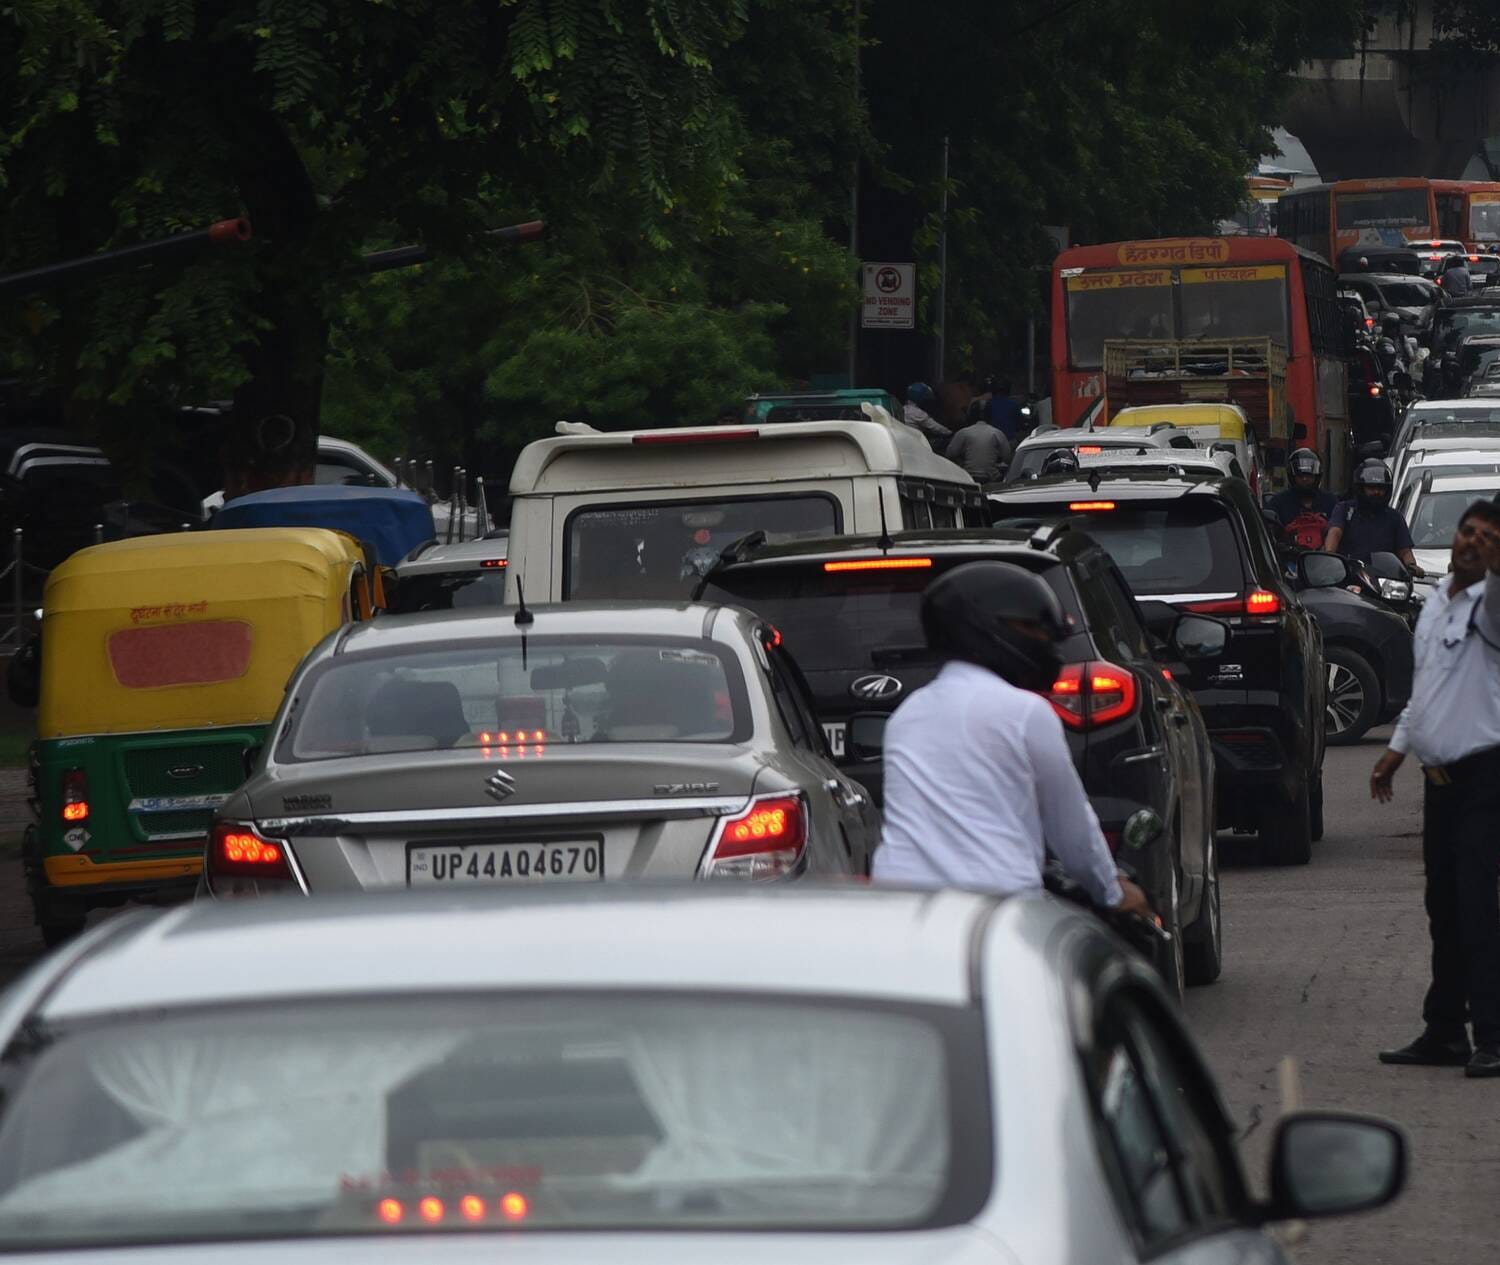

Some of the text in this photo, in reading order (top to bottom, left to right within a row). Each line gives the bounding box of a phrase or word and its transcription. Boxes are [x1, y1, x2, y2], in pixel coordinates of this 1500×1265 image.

[879, 297, 911, 305] VENDING
[879, 307, 898, 316] ZONE
[432, 846, 598, 880] UP44AQ4670
